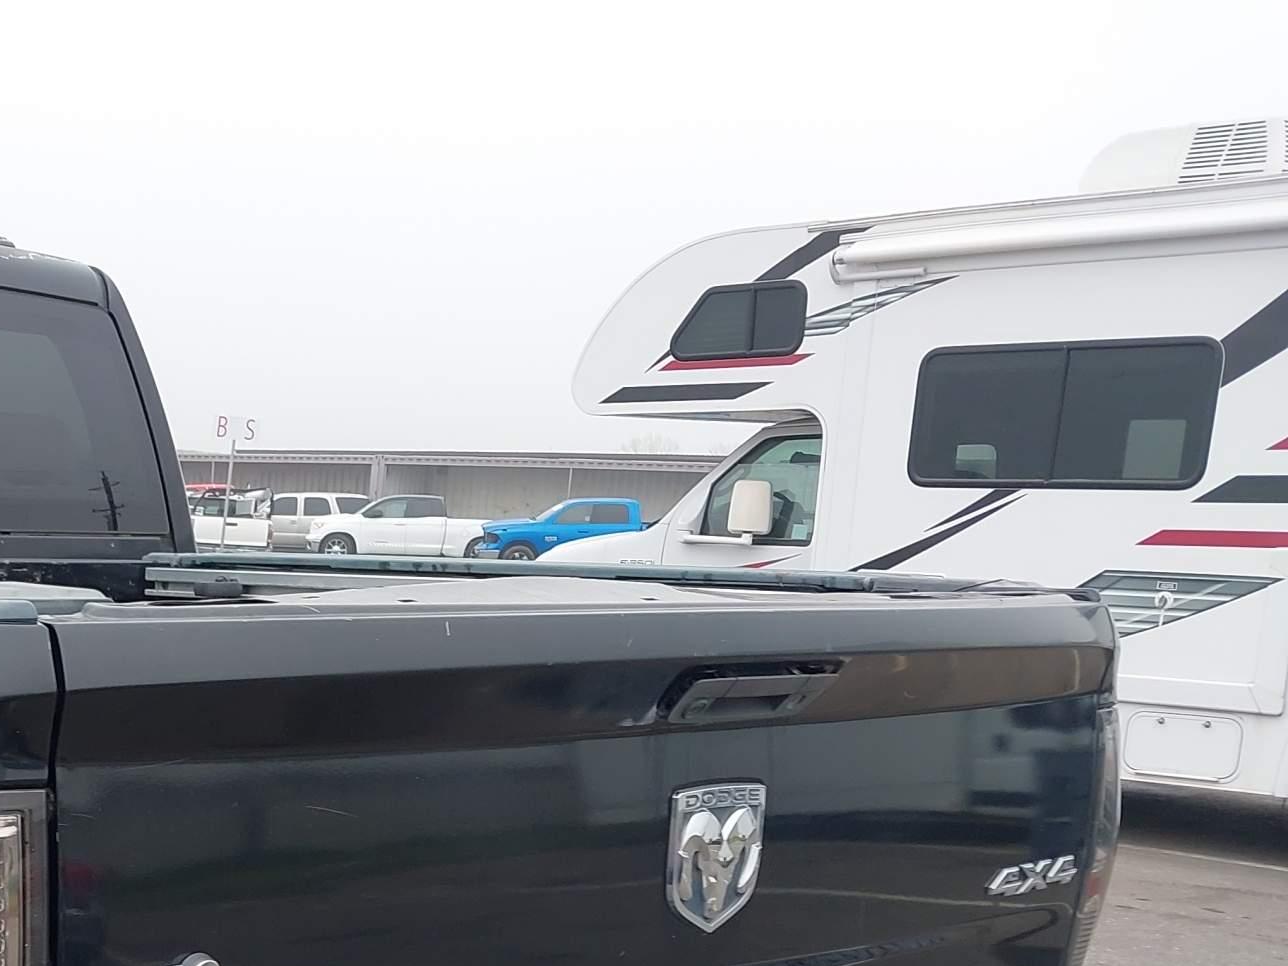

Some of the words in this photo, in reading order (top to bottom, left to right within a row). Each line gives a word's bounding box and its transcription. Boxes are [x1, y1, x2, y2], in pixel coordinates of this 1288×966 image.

[216, 415, 228, 438] B
[244, 418, 256, 441] S
[679, 786, 762, 812] DODGE
